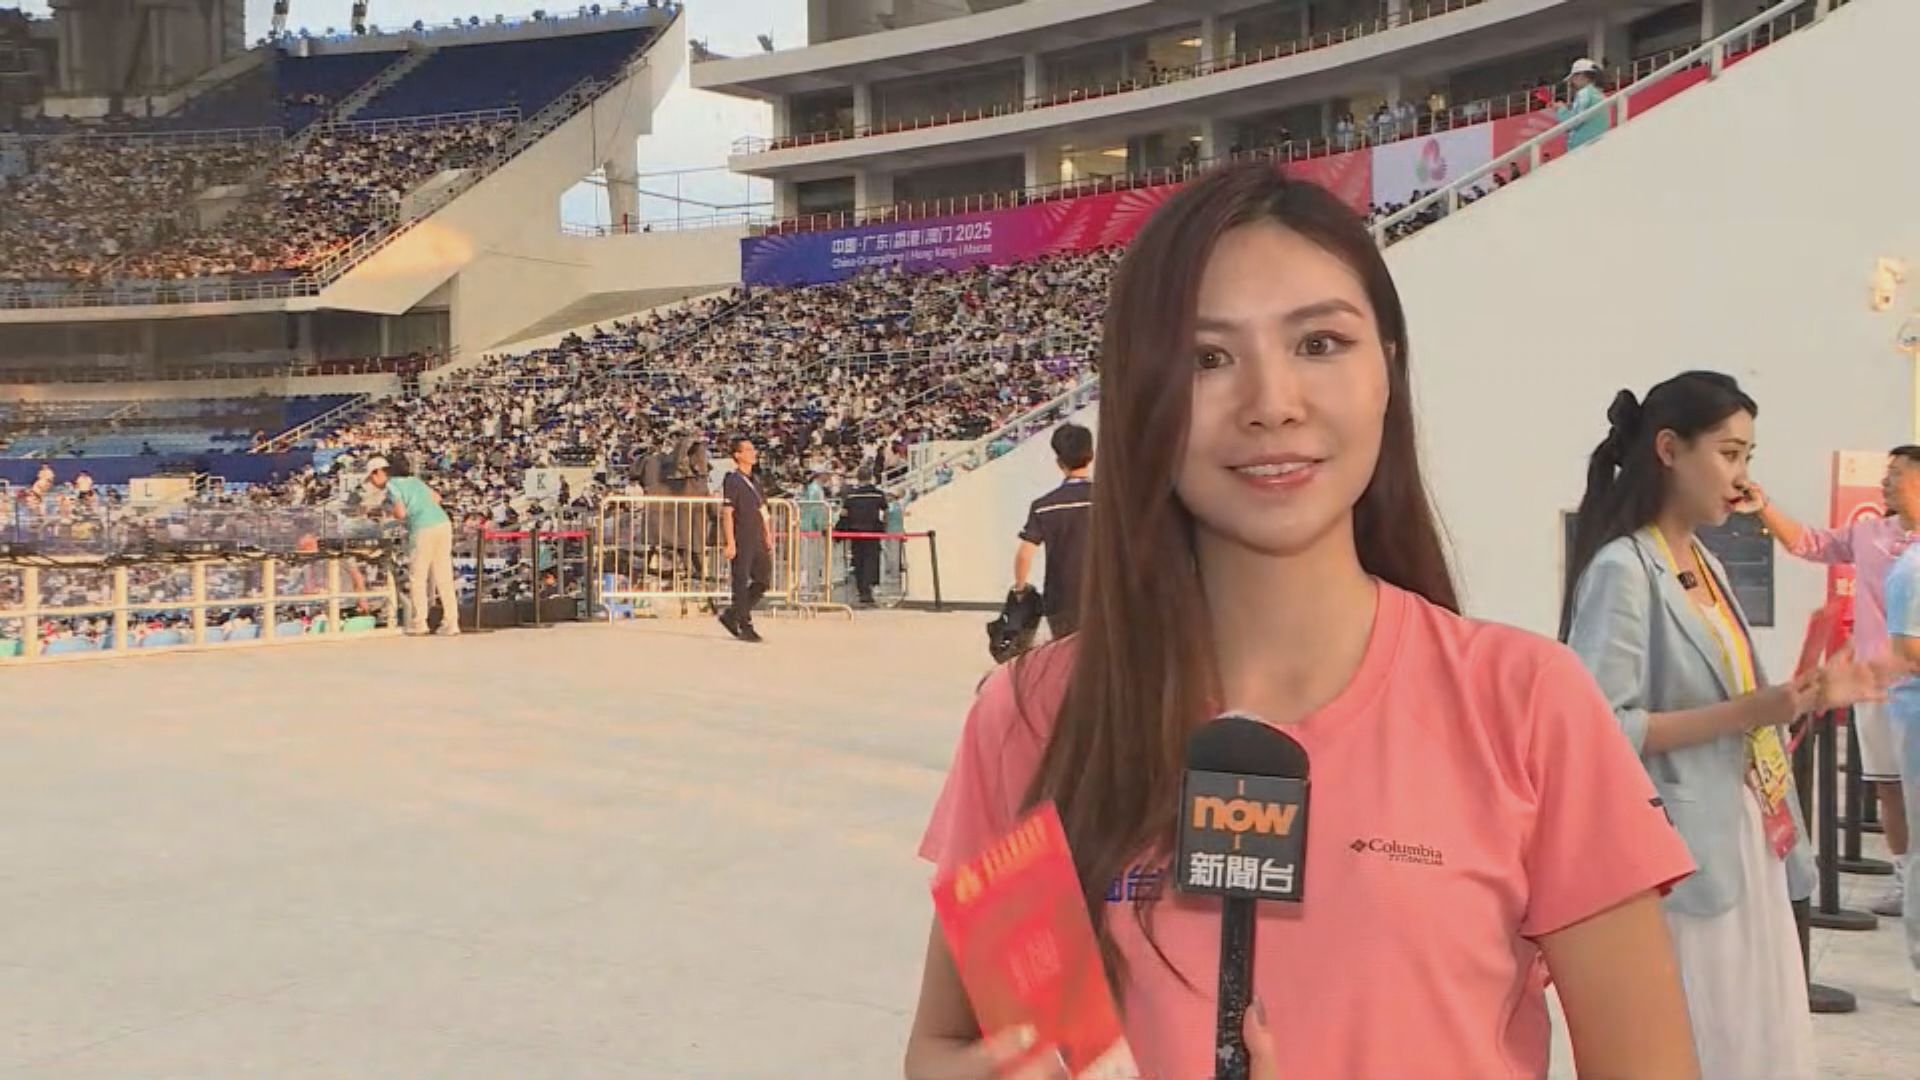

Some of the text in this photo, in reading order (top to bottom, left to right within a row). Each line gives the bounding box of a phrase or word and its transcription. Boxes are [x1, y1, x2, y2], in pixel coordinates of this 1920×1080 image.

[955, 221, 993, 242] 2025
[1192, 795, 1298, 837] now
[1368, 838, 1443, 859] Columbia
[1188, 852, 1295, 894] 新聞台
